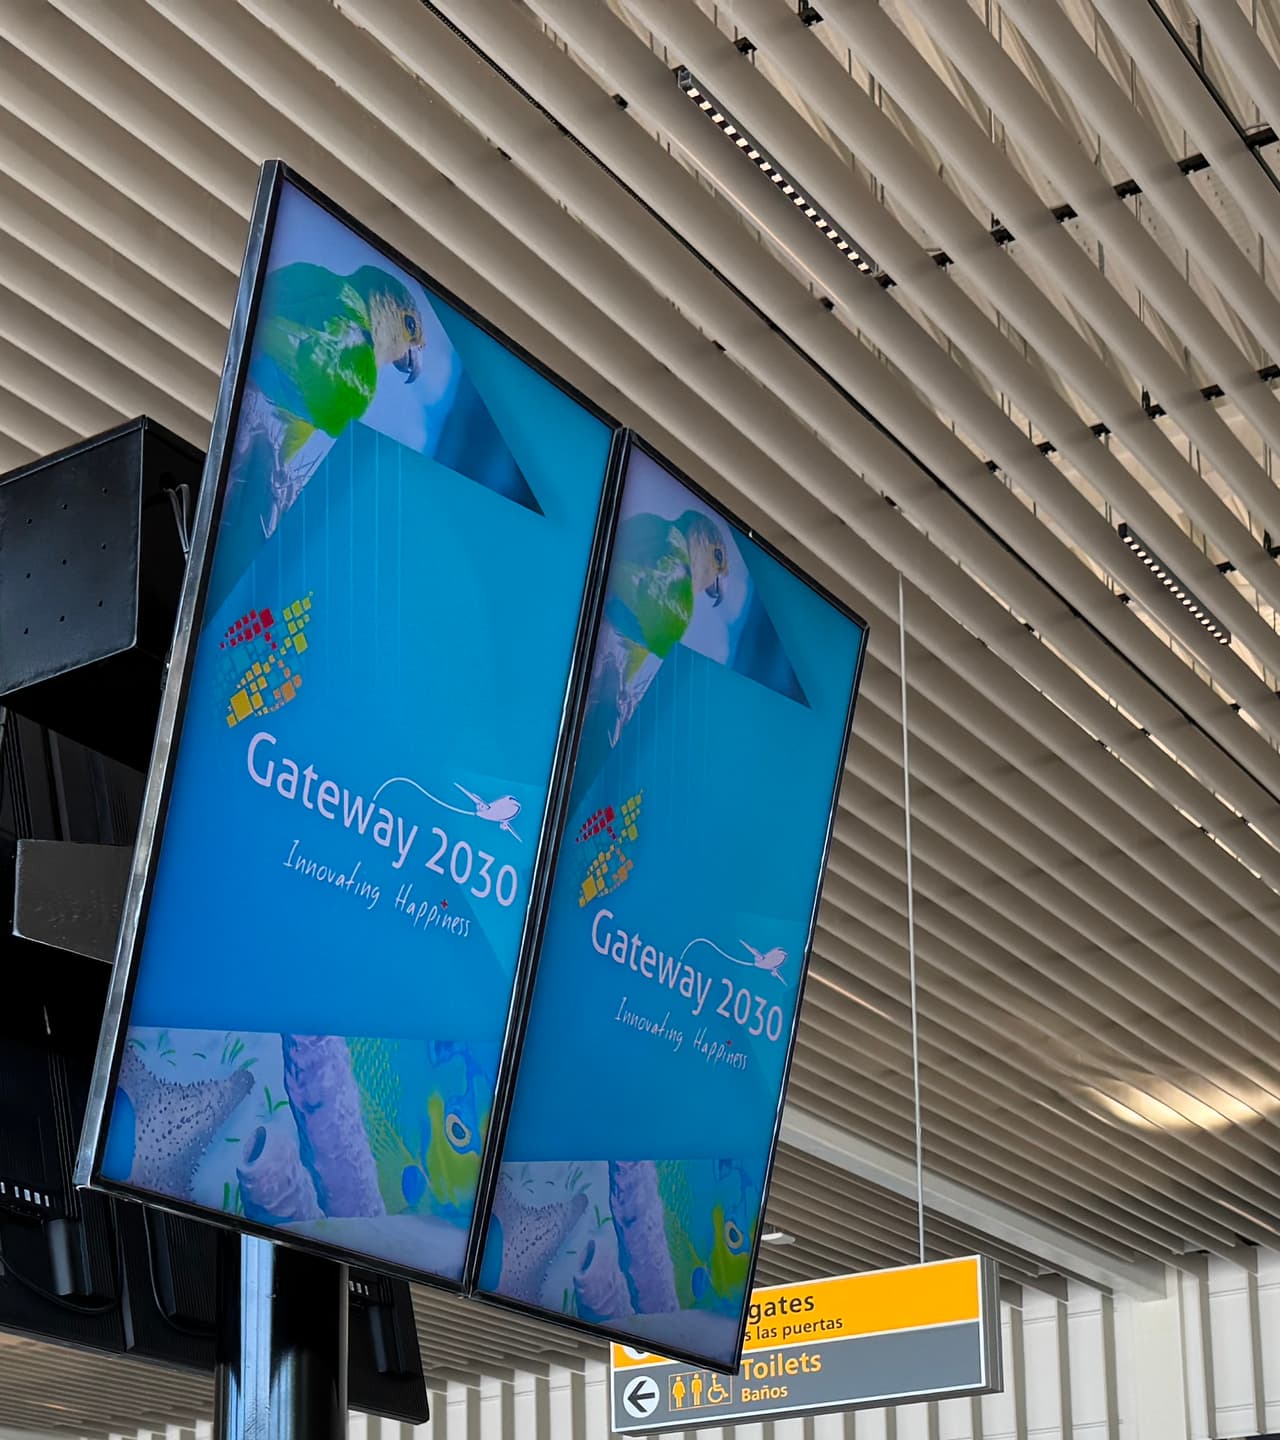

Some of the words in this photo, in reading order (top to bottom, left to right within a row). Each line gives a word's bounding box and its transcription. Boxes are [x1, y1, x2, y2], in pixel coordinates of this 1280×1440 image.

[246, 731, 419, 870] Gateway
[425, 826, 518, 907] 2030
[282, 838, 381, 911] Innovating
[394, 883, 472, 938] Happiness
[591, 908, 713, 1016] Gateway
[716, 977, 783, 1042] 2030
[615, 996, 684, 1052] Innovating
[693, 1026, 748, 1072] Happiness
[748, 1295, 815, 1325] gates
[756, 1325, 778, 1340] las
[782, 1317, 844, 1340] puertas
[740, 1352, 822, 1381] Toilets
[741, 1384, 789, 1403] Baños
